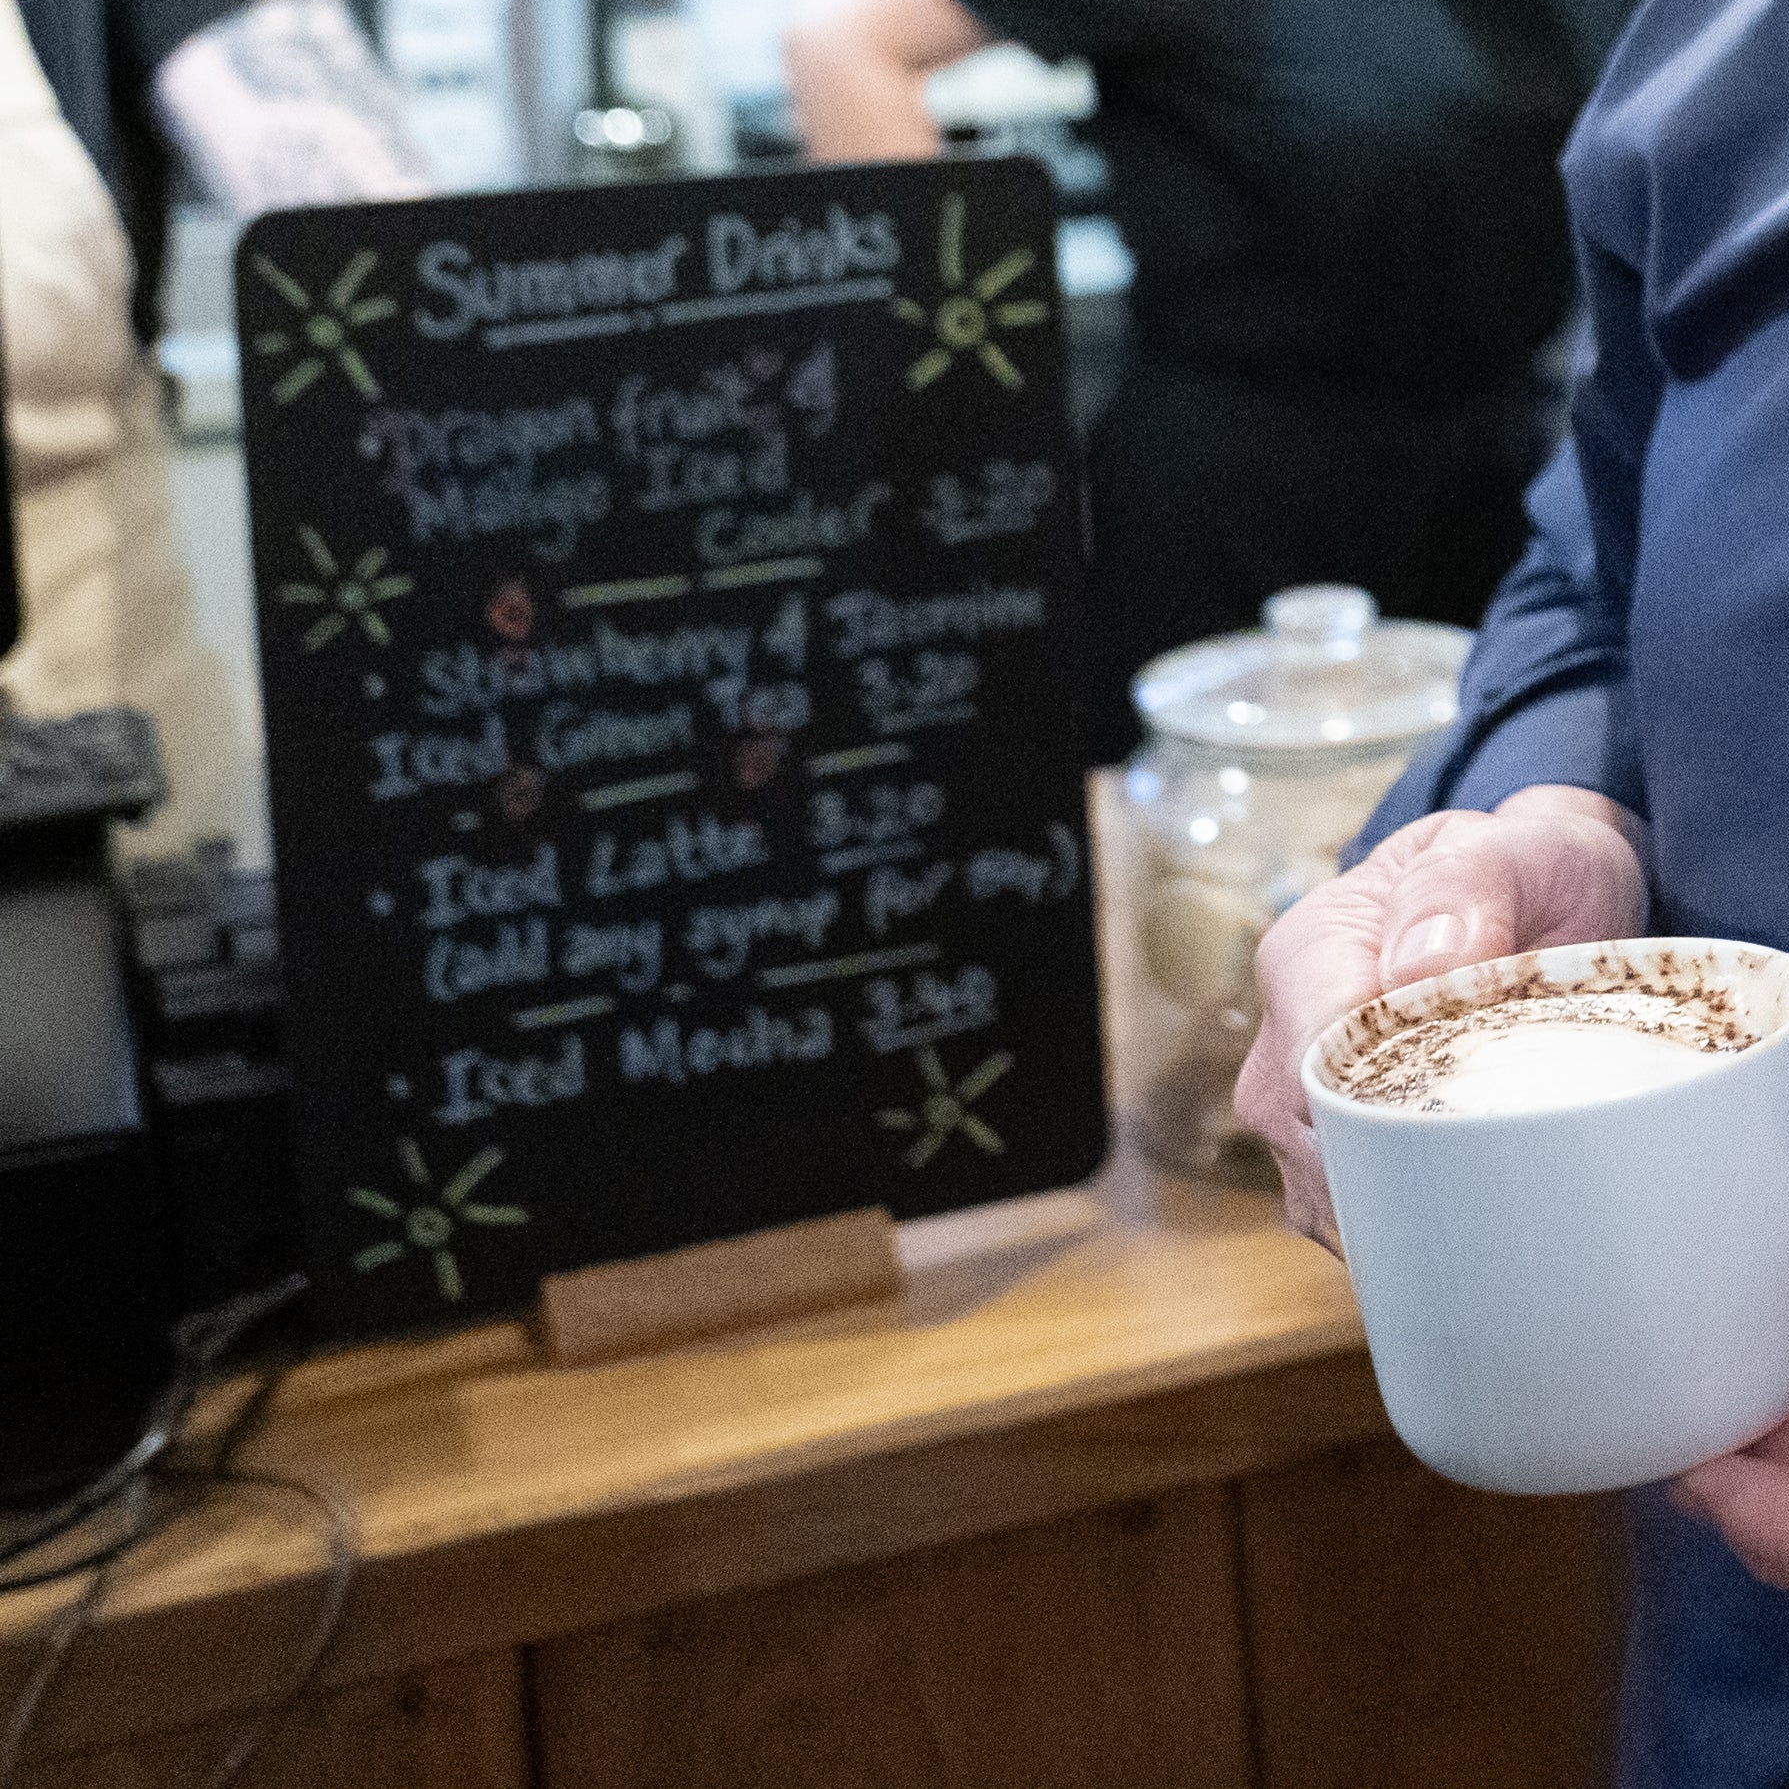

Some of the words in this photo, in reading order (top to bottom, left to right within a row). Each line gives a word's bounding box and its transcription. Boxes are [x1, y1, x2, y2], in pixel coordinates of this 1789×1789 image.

[413, 235, 690, 341] Summer
[706, 205, 902, 294] Drinks
[636, 430, 792, 512] Iced
[420, 618, 754, 718] Strawberry
[370, 713, 512, 802] Iced
[537, 700, 696, 770] Green
[418, 840, 564, 928] Iced
[587, 813, 767, 896] Latte
[562, 917, 665, 992] any
[684, 888, 840, 980] syrup
[433, 1032, 590, 1126] Iced
[618, 1005, 835, 1084] Mocha
